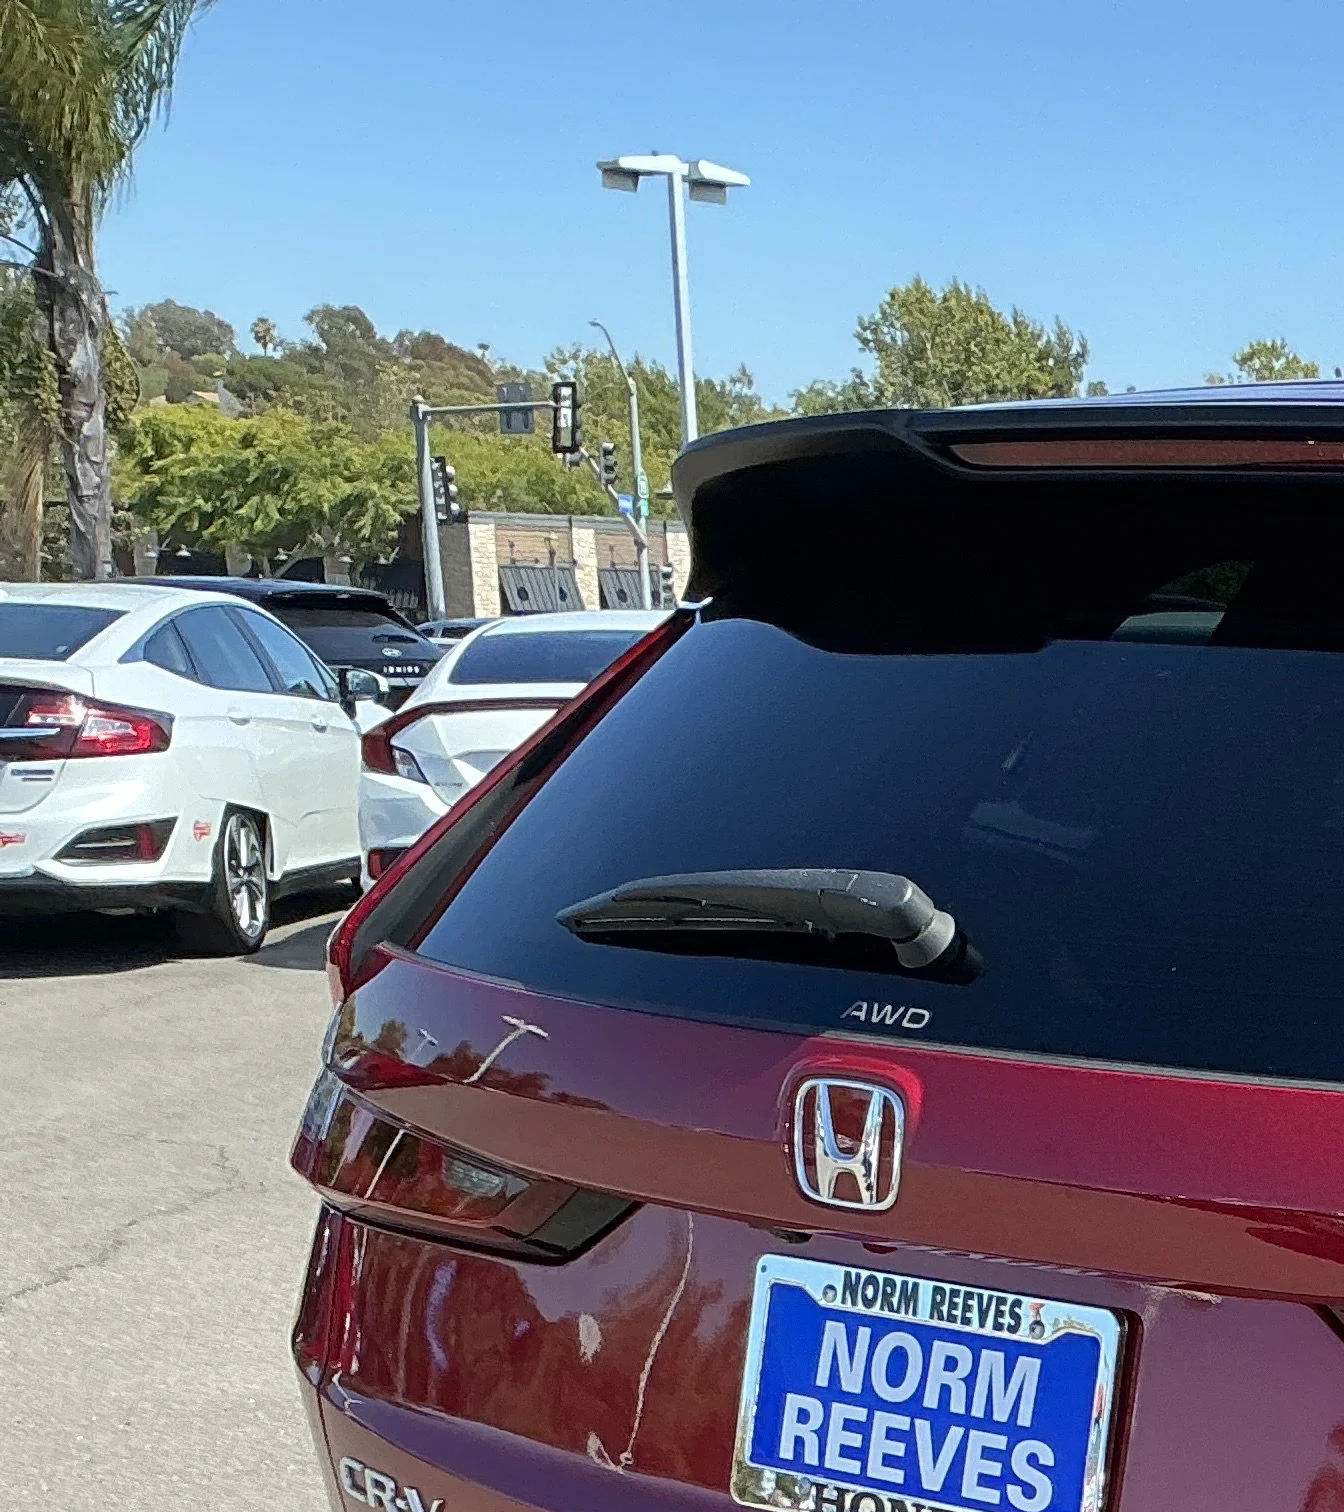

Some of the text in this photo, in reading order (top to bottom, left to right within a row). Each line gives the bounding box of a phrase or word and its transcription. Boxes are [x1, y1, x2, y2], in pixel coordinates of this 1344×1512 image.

[840, 1001, 930, 1029] AWD
[840, 1270, 1023, 1334] NORM REEVES
[815, 1320, 1042, 1427] NORM
[778, 1393, 1055, 1512] REEVES
